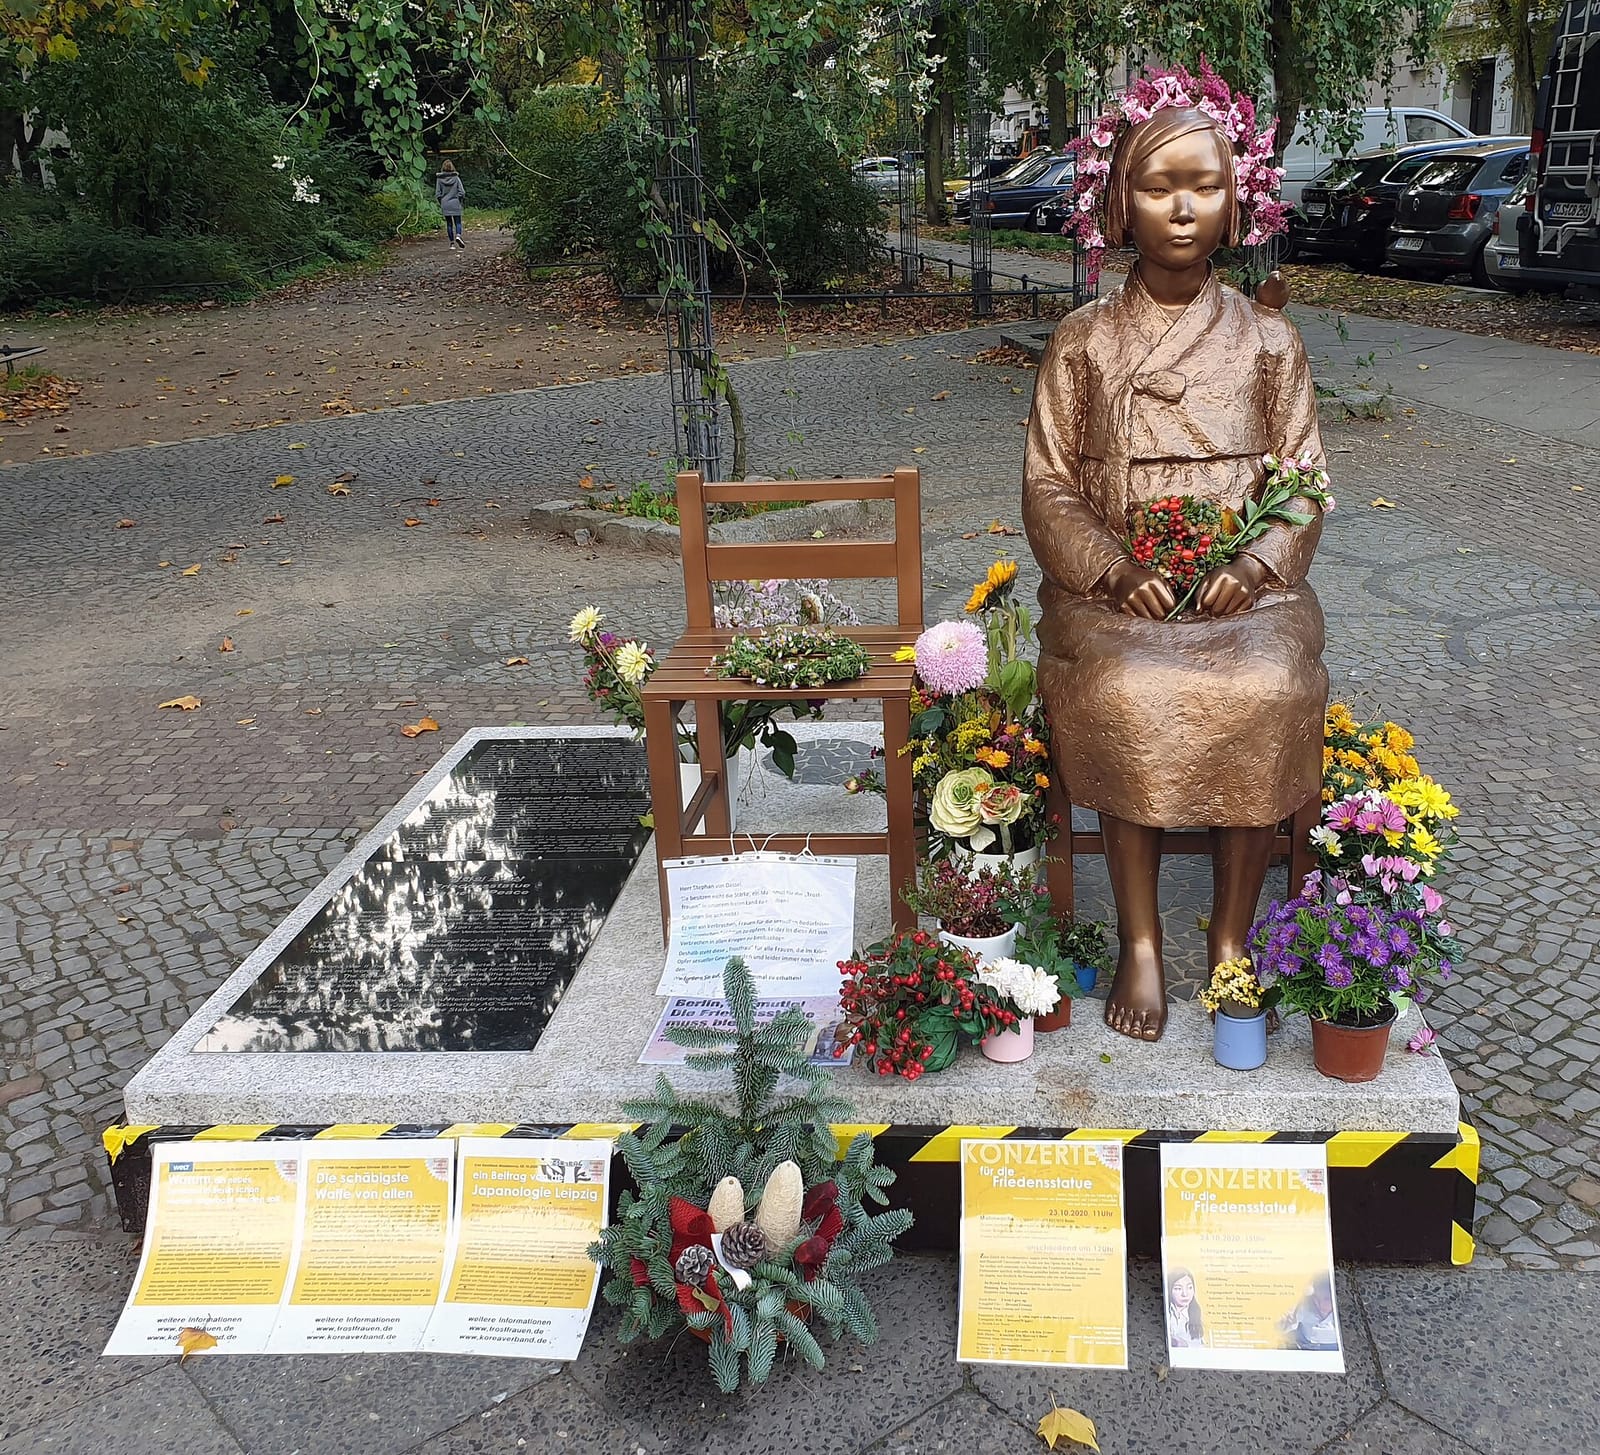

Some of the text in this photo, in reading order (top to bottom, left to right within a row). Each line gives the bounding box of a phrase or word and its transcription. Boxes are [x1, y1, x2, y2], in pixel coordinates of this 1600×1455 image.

[692, 883, 714, 891] Stephan
[680, 939, 709, 947] Verbrechen
[675, 999, 723, 1009] Berlin,
[670, 1009, 697, 1018] Die
[665, 1019, 710, 1028] muss
[965, 1144, 1096, 1166] KONZERTE
[980, 1165, 1015, 1177] für die
[314, 1171, 409, 1186] Die schäbigste
[472, 1171, 488, 1180] ein
[490, 1171, 527, 1183] Beitrag
[1165, 1168, 1299, 1190] KONZERTE
[993, 1176, 1093, 1190] Friedensstatue
[314, 1187, 414, 1200] Waffe von allen
[471, 1185, 598, 1202] Japanologie Leipzig
[1181, 1191, 1217, 1202] für die
[1048, 1208, 1088, 1217] 23.10.2020
[1194, 1200, 1297, 1214] Friedensstatue
[498, 1317, 552, 1326] Informationen
[316, 1325, 393, 1333] www.trostfrauen.de
[469, 1325, 544, 1335] www.trostfrauen.de
[306, 1334, 397, 1342] www.koreaverband.de
[458, 1334, 547, 1345] www.koreaverband.de
